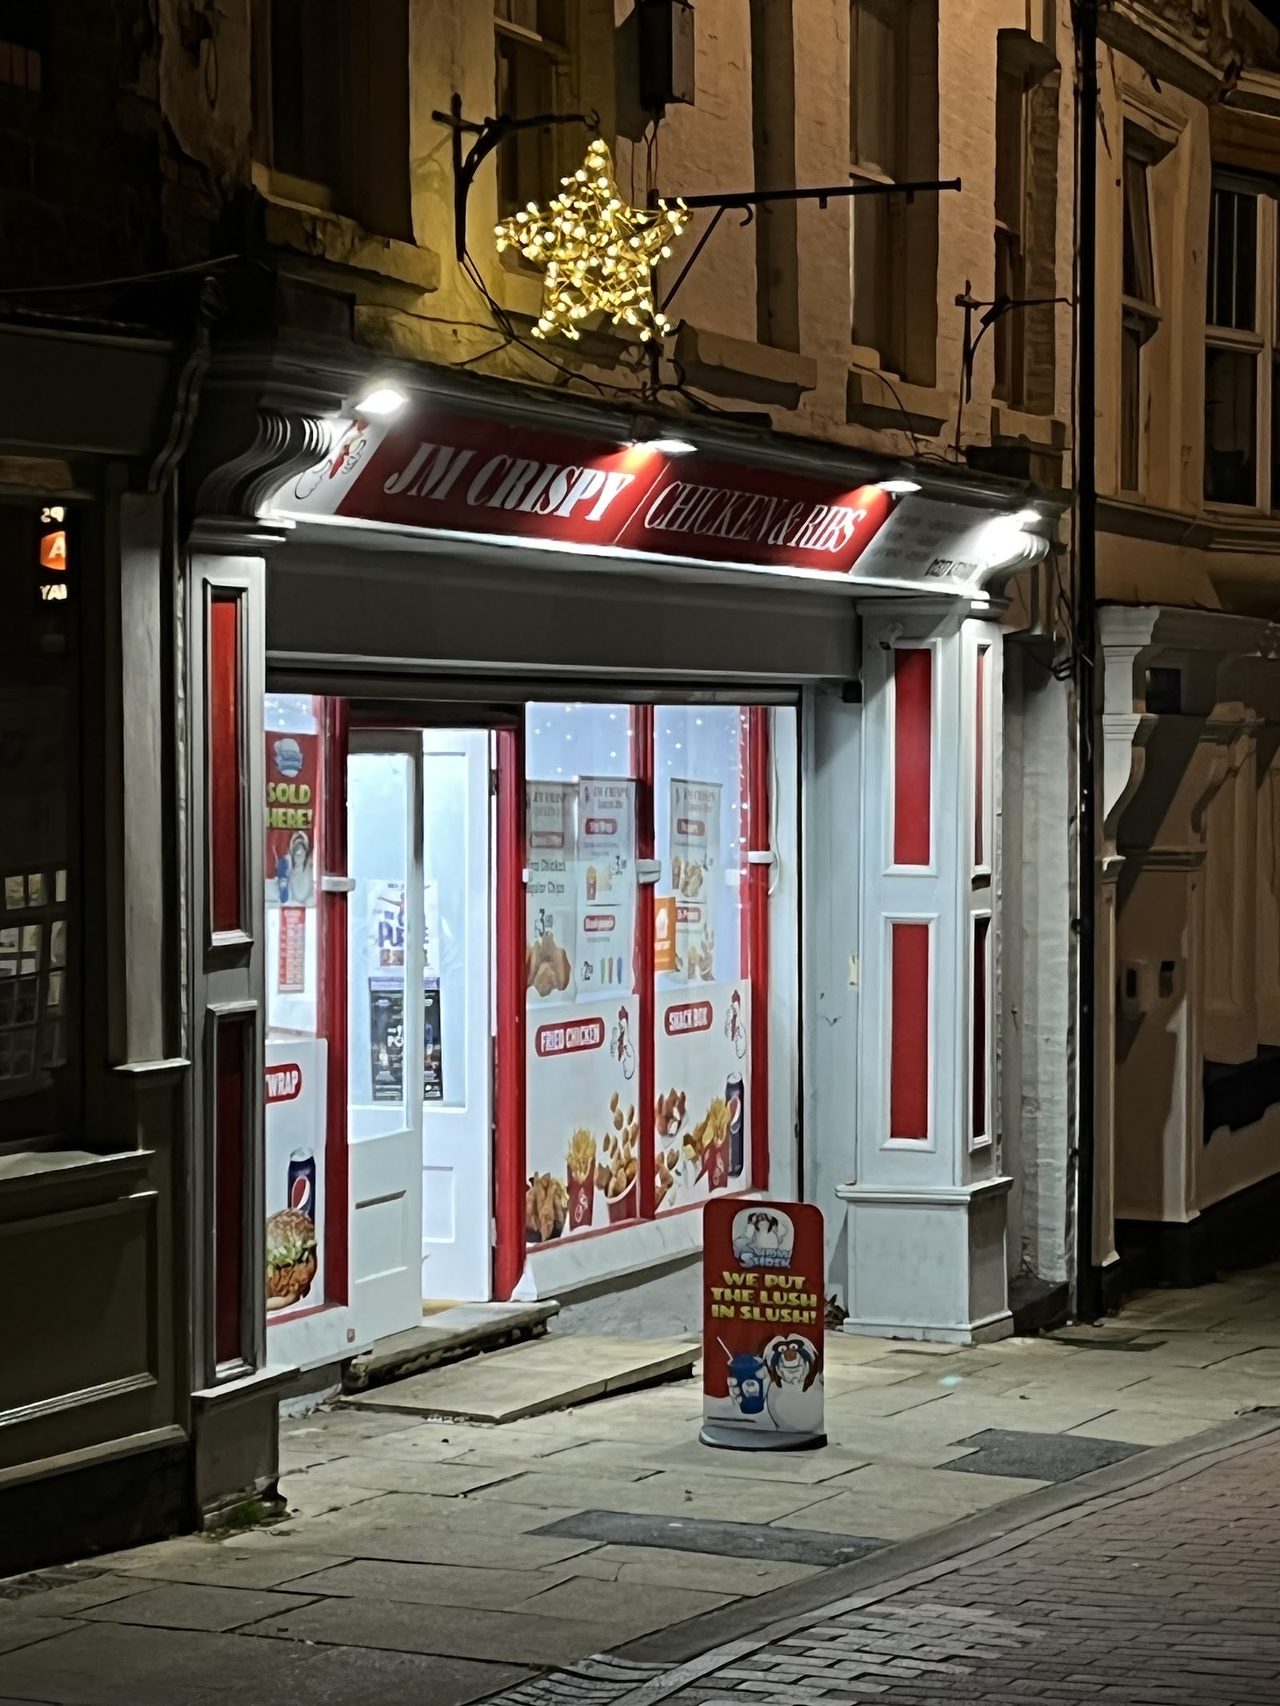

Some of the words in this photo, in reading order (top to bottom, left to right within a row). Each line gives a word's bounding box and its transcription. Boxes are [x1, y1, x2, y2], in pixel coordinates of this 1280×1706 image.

[383, 441, 476, 500] JM
[467, 454, 636, 522] CRISPY
[644, 481, 789, 542] CHICKEN
[767, 501, 804, 545] &
[787, 504, 868, 553] RIBS
[266, 781, 311, 804] SOLD
[265, 1067, 299, 1097] WRAP
[722, 1271, 760, 1287] WE
[764, 1274, 806, 1290] PUT
[710, 1287, 755, 1303] THE
[760, 1290, 817, 1307] LUSH
[711, 1304, 735, 1318] IN
[740, 1305, 817, 1324] SLUSH!
